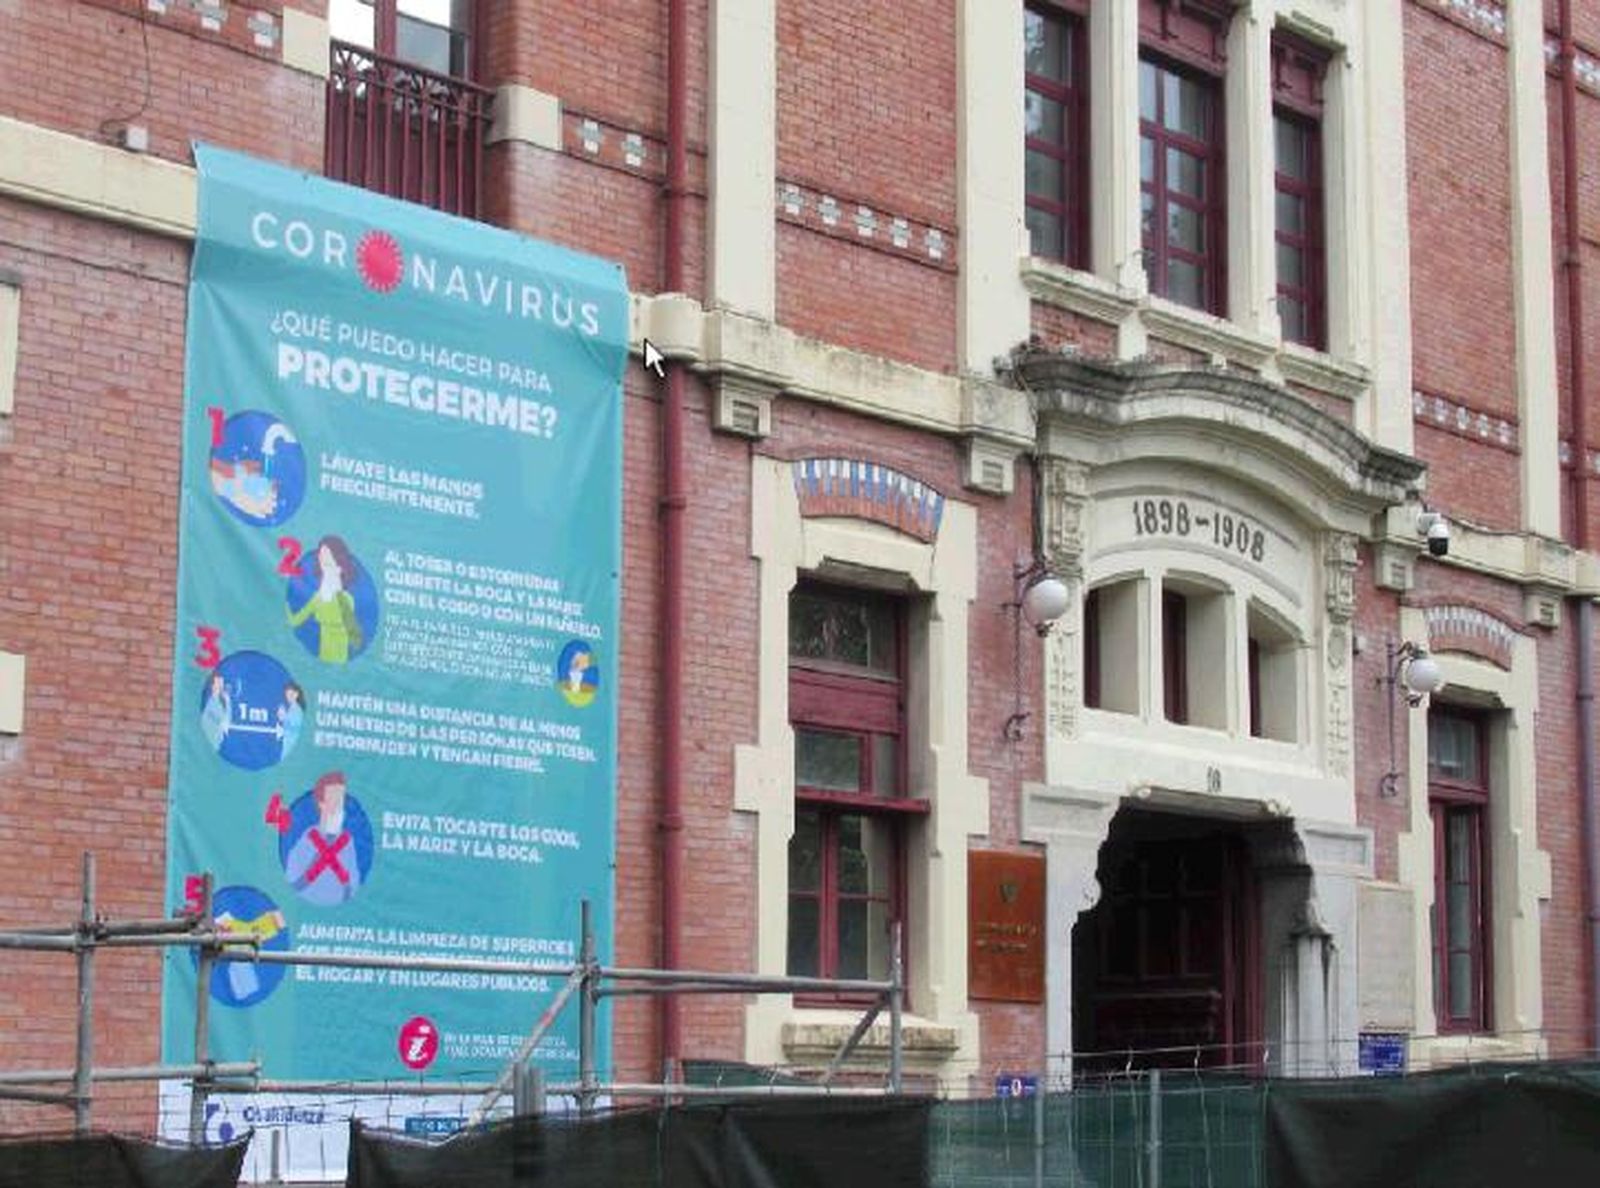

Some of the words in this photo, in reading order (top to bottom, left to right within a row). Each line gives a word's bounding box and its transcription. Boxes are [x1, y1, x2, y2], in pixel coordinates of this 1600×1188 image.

[337, 323, 414, 358] PUEDO
[420, 345, 493, 379] HACER
[499, 361, 553, 393] PARA
[277, 342, 558, 440] PROTEGERME?
[208, 407, 226, 447] 1
[276, 536, 304, 578] 2
[194, 626, 221, 669] 3
[264, 792, 293, 834] 4
[383, 811, 432, 832] EVITA
[461, 838, 472, 856] Y
